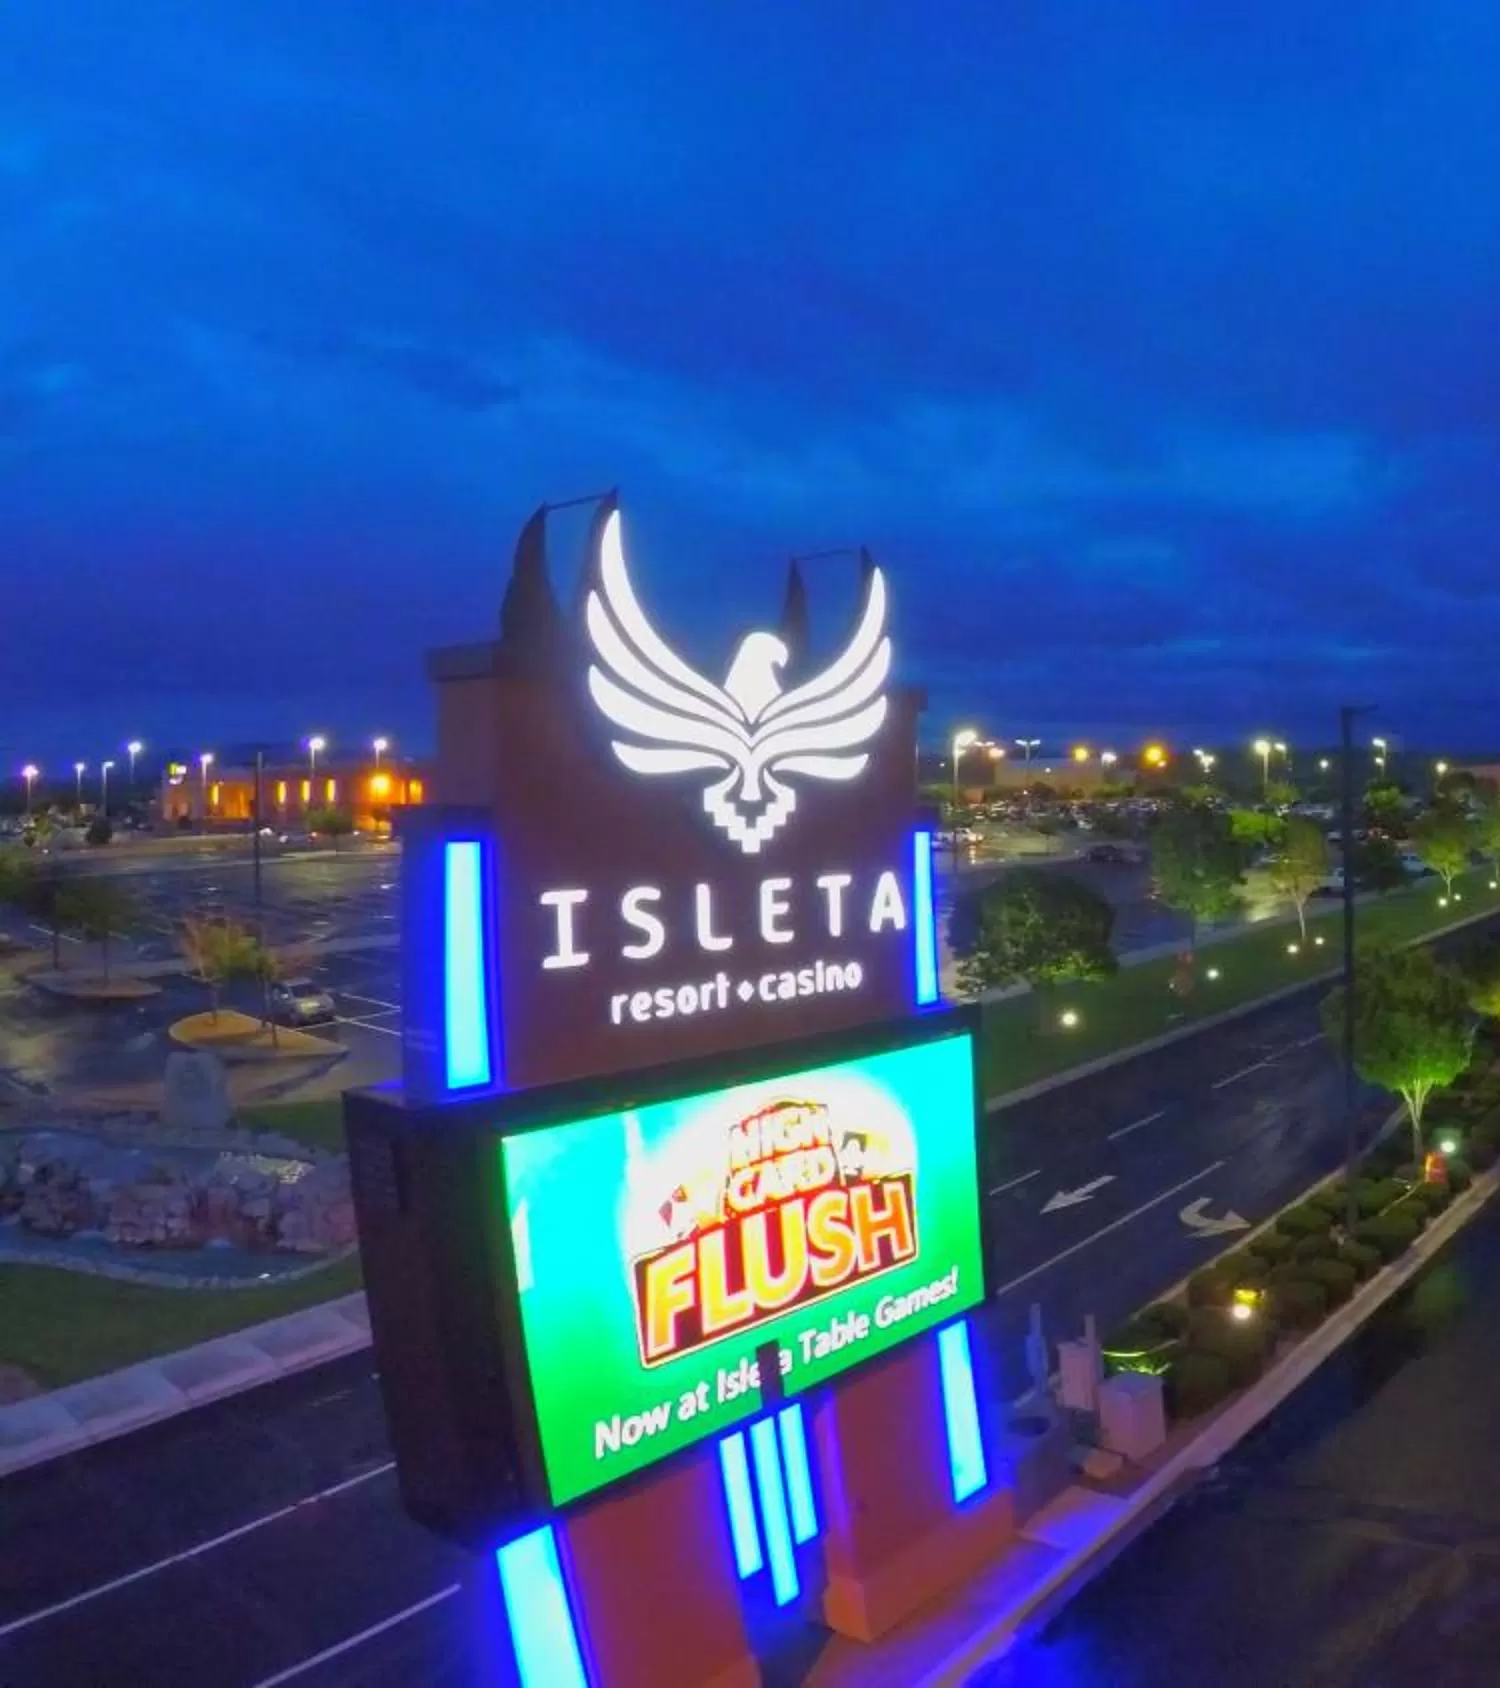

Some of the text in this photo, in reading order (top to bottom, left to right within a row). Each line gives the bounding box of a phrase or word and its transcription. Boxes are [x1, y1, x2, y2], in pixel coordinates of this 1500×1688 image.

[540, 871, 906, 969] ISLETA
[610, 960, 863, 1025] resort casino
[728, 1103, 833, 1168] HIGH
[725, 1146, 836, 1213] CARD
[645, 1179, 915, 1358] FLUSH
[594, 1265, 960, 1459] Now at Islea Table Games!
